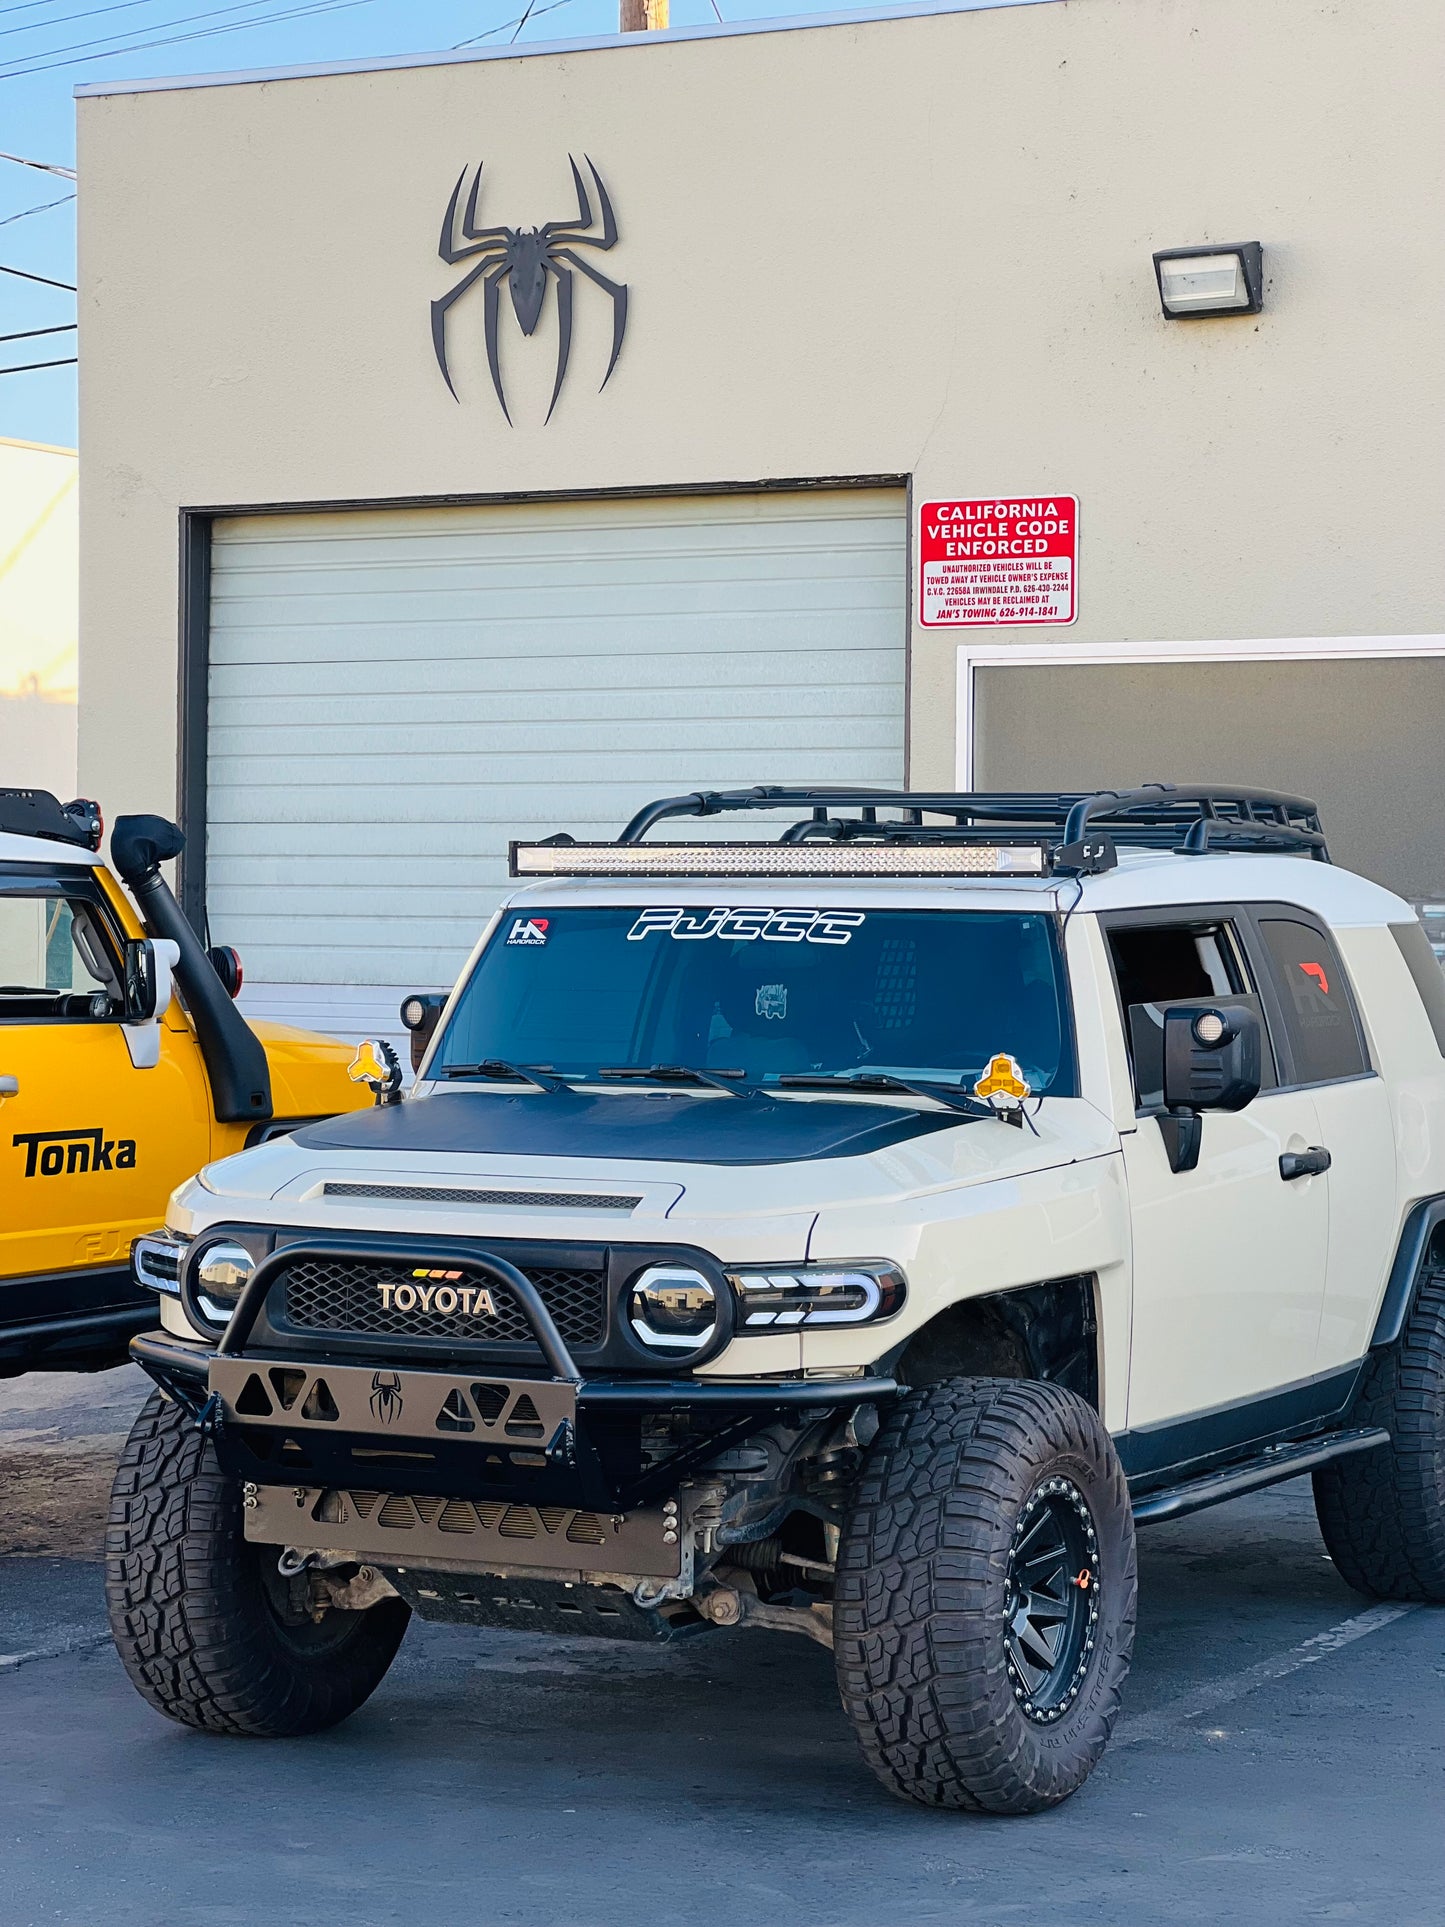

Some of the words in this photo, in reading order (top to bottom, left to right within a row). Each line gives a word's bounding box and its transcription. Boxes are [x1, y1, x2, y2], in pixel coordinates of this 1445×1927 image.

[937, 502, 1058, 521] CALIFORNIA
[927, 522, 1008, 539] VEHICLE
[1015, 520, 1069, 536] CODE
[946, 539, 1048, 556] ENFORCED
[942, 563, 991, 573] UNAUTHORIZED
[993, 562, 1023, 571] VEHICLES
[1026, 561, 1042, 570] WILL
[1044, 561, 1052, 570] BE
[927, 576, 949, 585] TOWED
[950, 575, 968, 584] AWAY
[970, 575, 977, 583] AT
[980, 574, 1006, 583] VEHICLE
[1008, 573, 1038, 582] OWNER'S
[1040, 572, 1068, 581] EXPENSE
[927, 587, 945, 596] C.V.C.
[947, 586, 971, 595] 22658A
[973, 585, 1008, 594] IRWINDALE
[1010, 585, 1021, 593] P.D.
[1024, 583, 1069, 593] 626-430-2244
[945, 598, 975, 606] VEHICLES
[978, 597, 991, 605] MAY
[993, 596, 1001, 605] BE
[1003, 595, 1039, 604] RECLAIMED
[1042, 595, 1049, 603] AT
[936, 609, 960, 619] JAN'S
[963, 608, 996, 618] TOWING
[999, 606, 1058, 617] 626-914-1841
[1083, 845, 1105, 858] FJ
[12, 1128, 136, 1177] Tonka
[377, 1283, 496, 1316] TOYOTA
